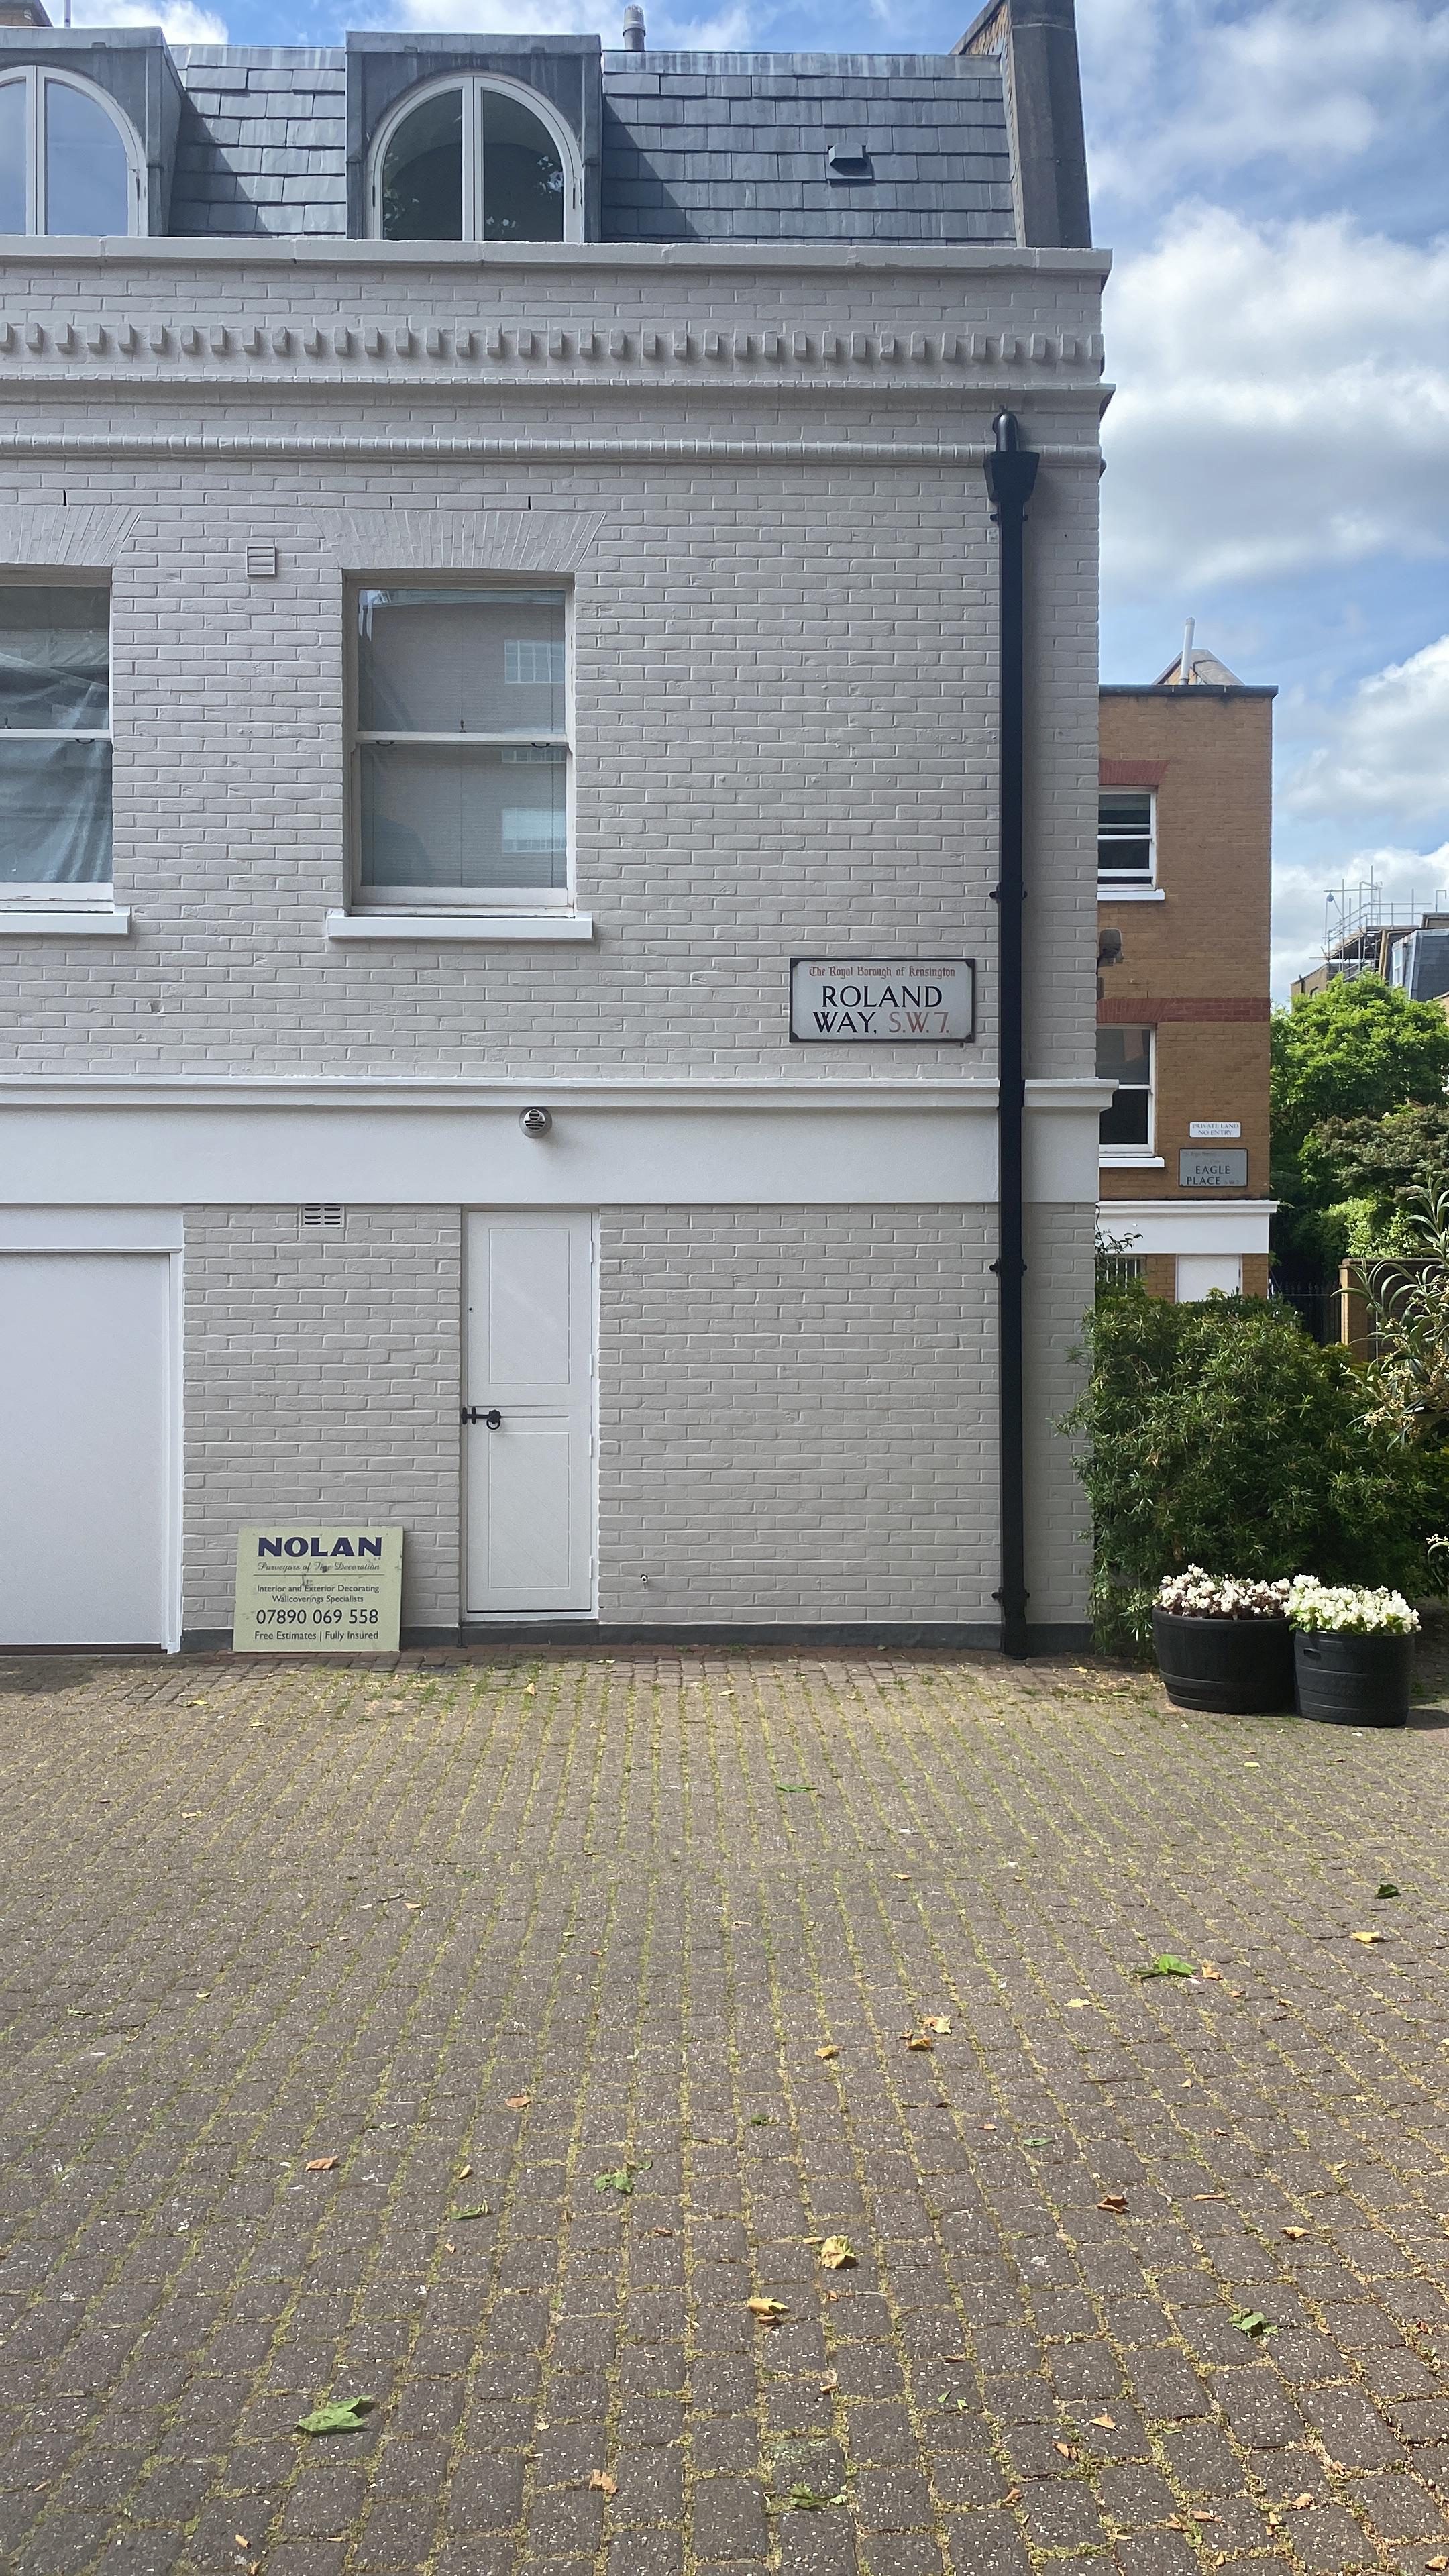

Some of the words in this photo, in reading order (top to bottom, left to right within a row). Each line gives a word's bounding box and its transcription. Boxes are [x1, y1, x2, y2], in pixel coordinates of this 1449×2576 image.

[809, 966, 826, 977] The
[828, 966, 853, 979] Royal
[857, 966, 892, 979] Borough
[896, 966, 905, 977] of
[909, 966, 955, 979] Kensington
[822, 985, 942, 1008] ROLAND
[812, 1012, 877, 1034] WAY,
[1195, 1165, 1231, 1174] EAGLE
[1187, 1176, 1221, 1185] PLACE
[258, 1536, 382, 1557] NOLAN
[257, 1562, 301, 1573] Purveyors
[302, 1562, 311, 1573] of
[334, 1562, 380, 1571] Decoration
[257, 1585, 286, 1593] Interior
[288, 1585, 302, 1593] and
[305, 1585, 335, 1593] Exterior
[337, 1585, 380, 1594] Decorating
[272, 1595, 324, 1604] Wallcoverings
[326, 1595, 364, 1604] Specialists
[256, 1609, 307, 1625] 07890
[313, 1609, 343, 1625] 069
[348, 1609, 378, 1624] 558
[254, 1631, 274, 1640] Free
[276, 1631, 317, 1640] Estimates
[325, 1631, 344, 1642] Fully
[347, 1631, 379, 1640] Insured
